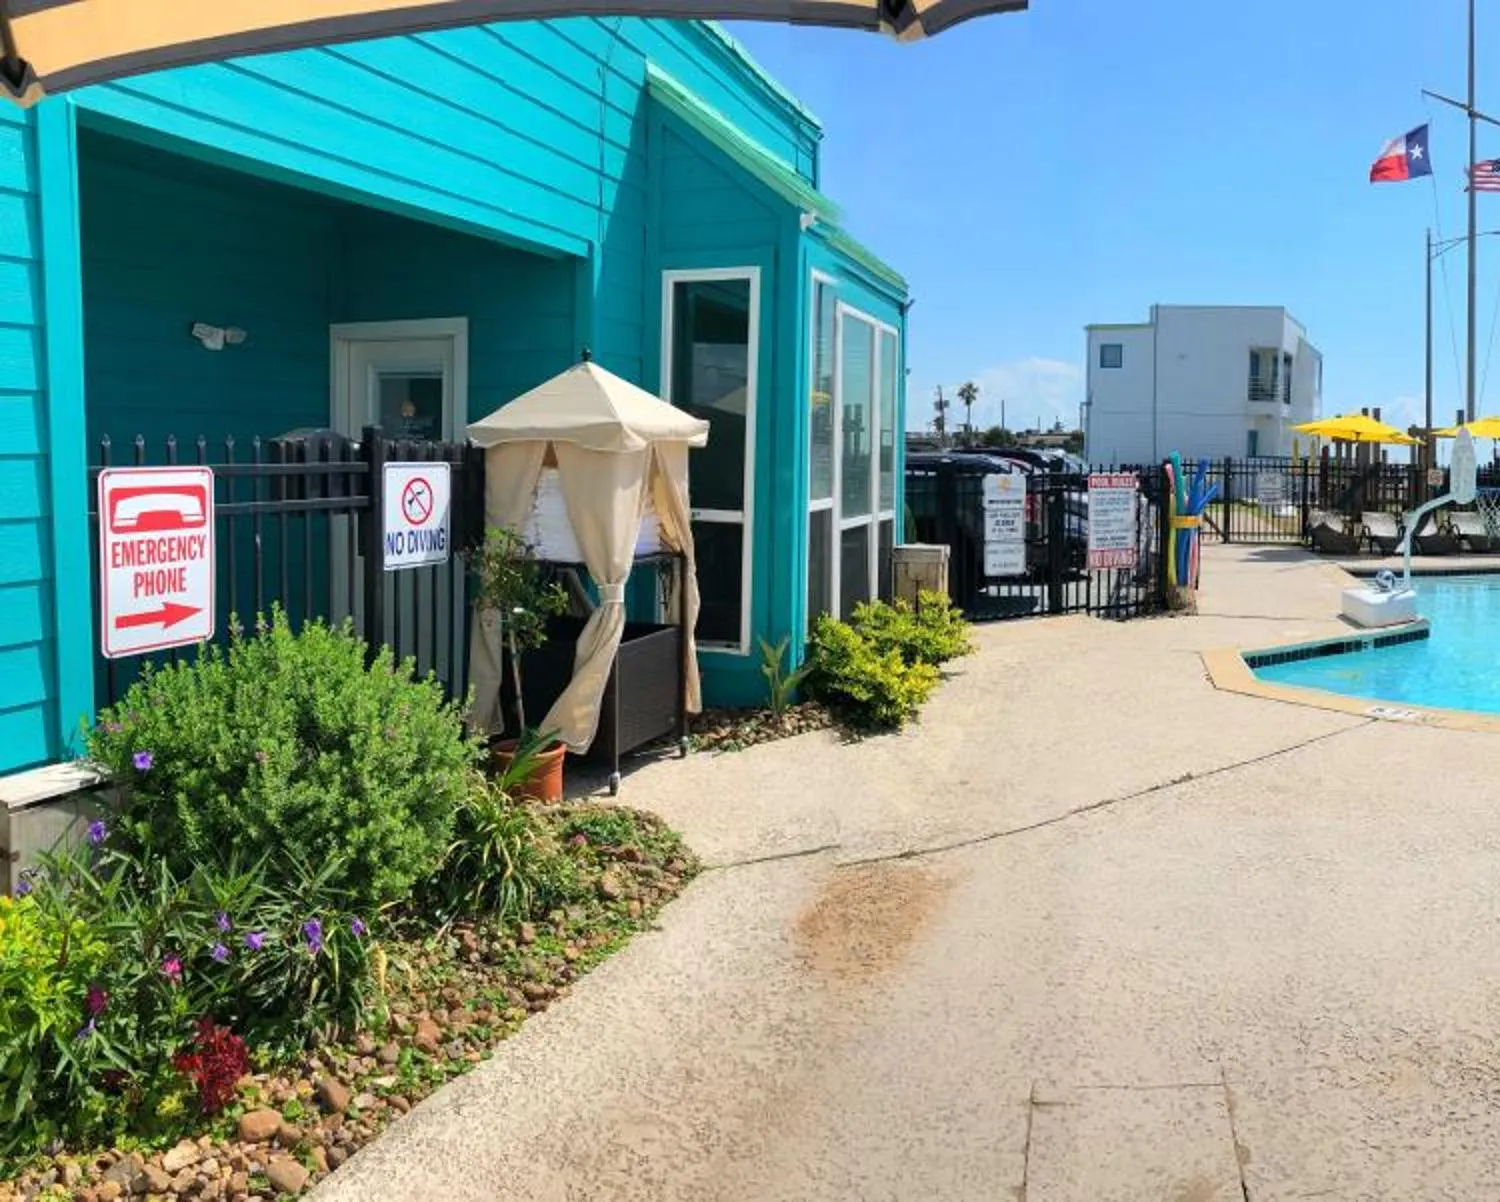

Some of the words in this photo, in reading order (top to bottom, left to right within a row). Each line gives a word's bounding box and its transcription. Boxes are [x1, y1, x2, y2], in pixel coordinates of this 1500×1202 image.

[111, 534, 206, 568] EMERGENCY
[386, 531, 405, 555] NO
[407, 527, 445, 554] DIVING
[133, 567, 187, 599] PHONE
